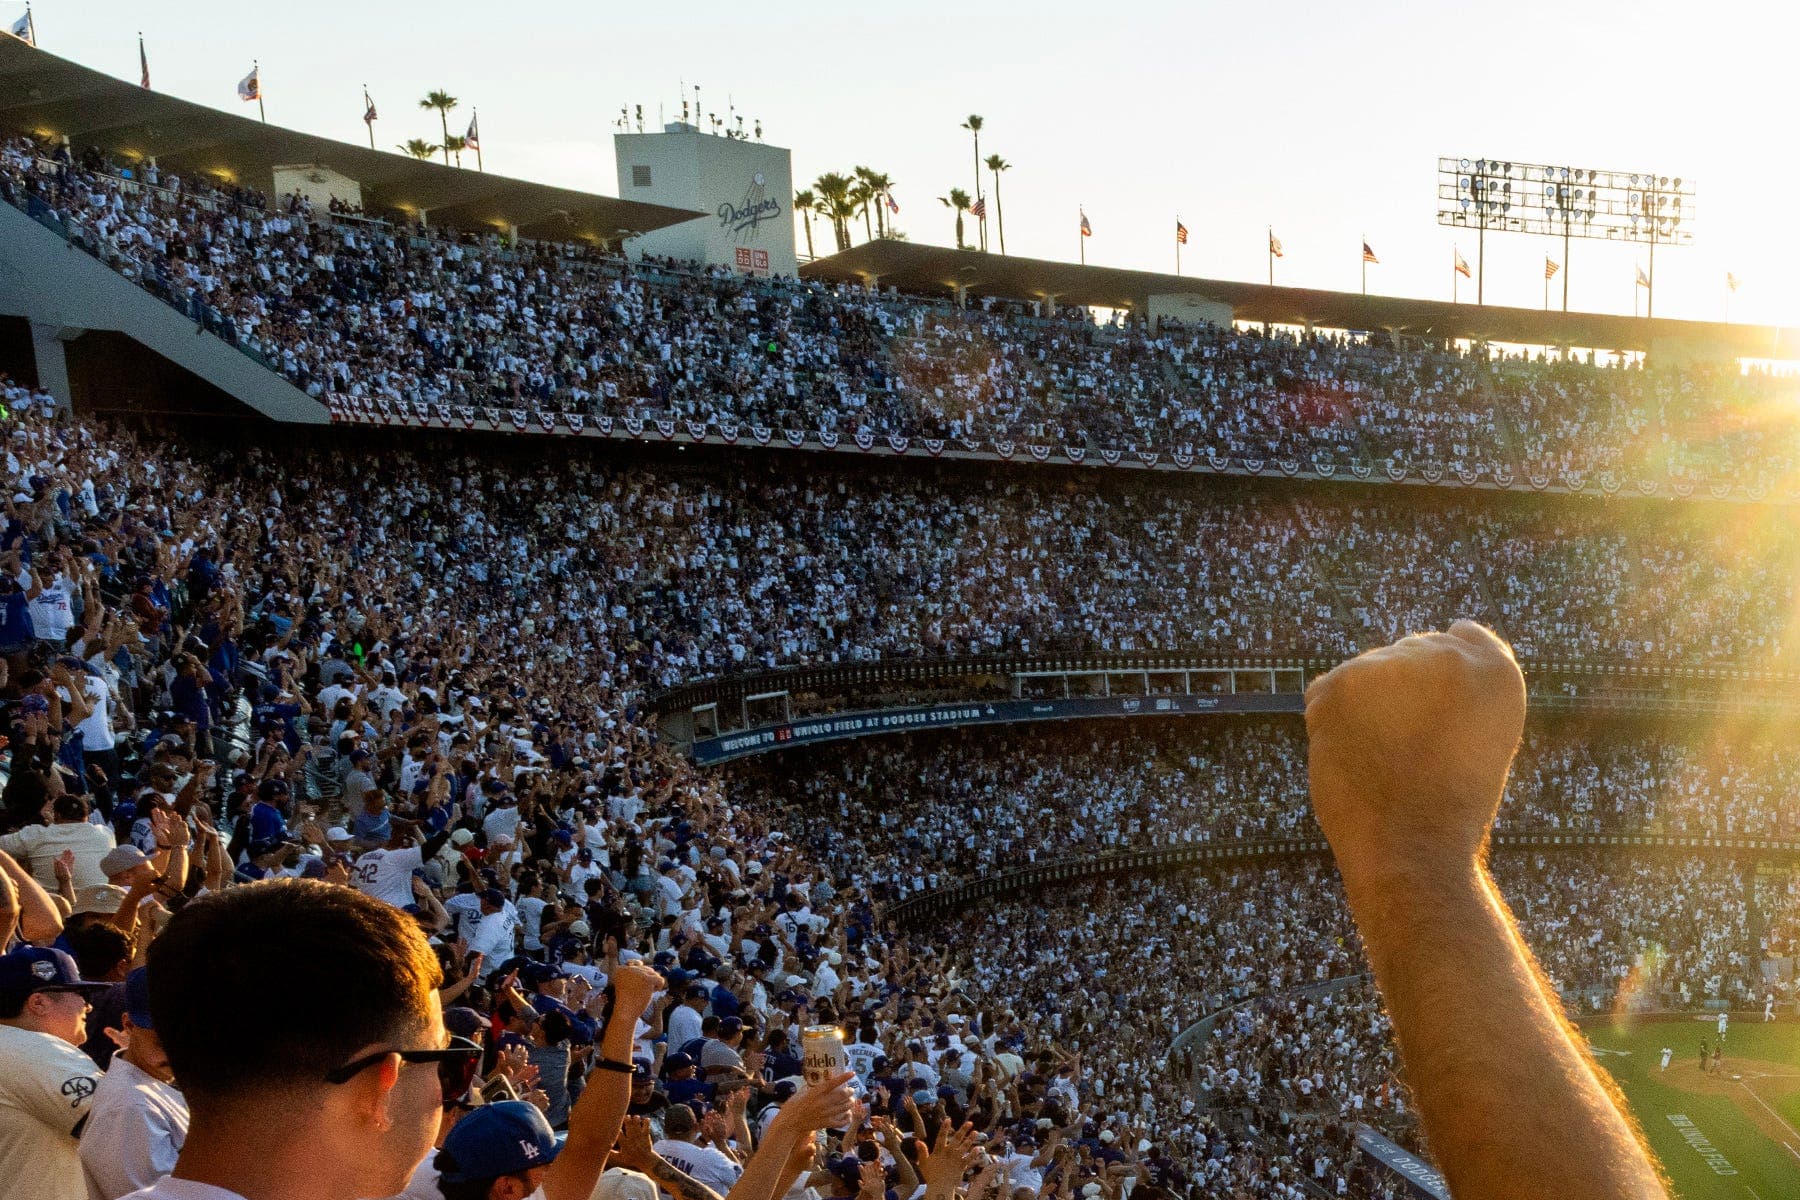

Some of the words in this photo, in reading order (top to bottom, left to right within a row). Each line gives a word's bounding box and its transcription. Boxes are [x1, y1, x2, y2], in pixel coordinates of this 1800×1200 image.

[718, 197, 781, 231] Dodgers
[722, 734, 761, 751] WELCOME
[762, 732, 775, 742] TO
[793, 723, 832, 737] UNIQLO
[834, 718, 863, 731] FIELD
[866, 717, 879, 727] AT
[882, 712, 927, 726] DODGER
[930, 709, 980, 721] STADIUM
[359, 864, 378, 883] 42
[855, 1057, 867, 1074] 5
[519, 1140, 540, 1160] LA
